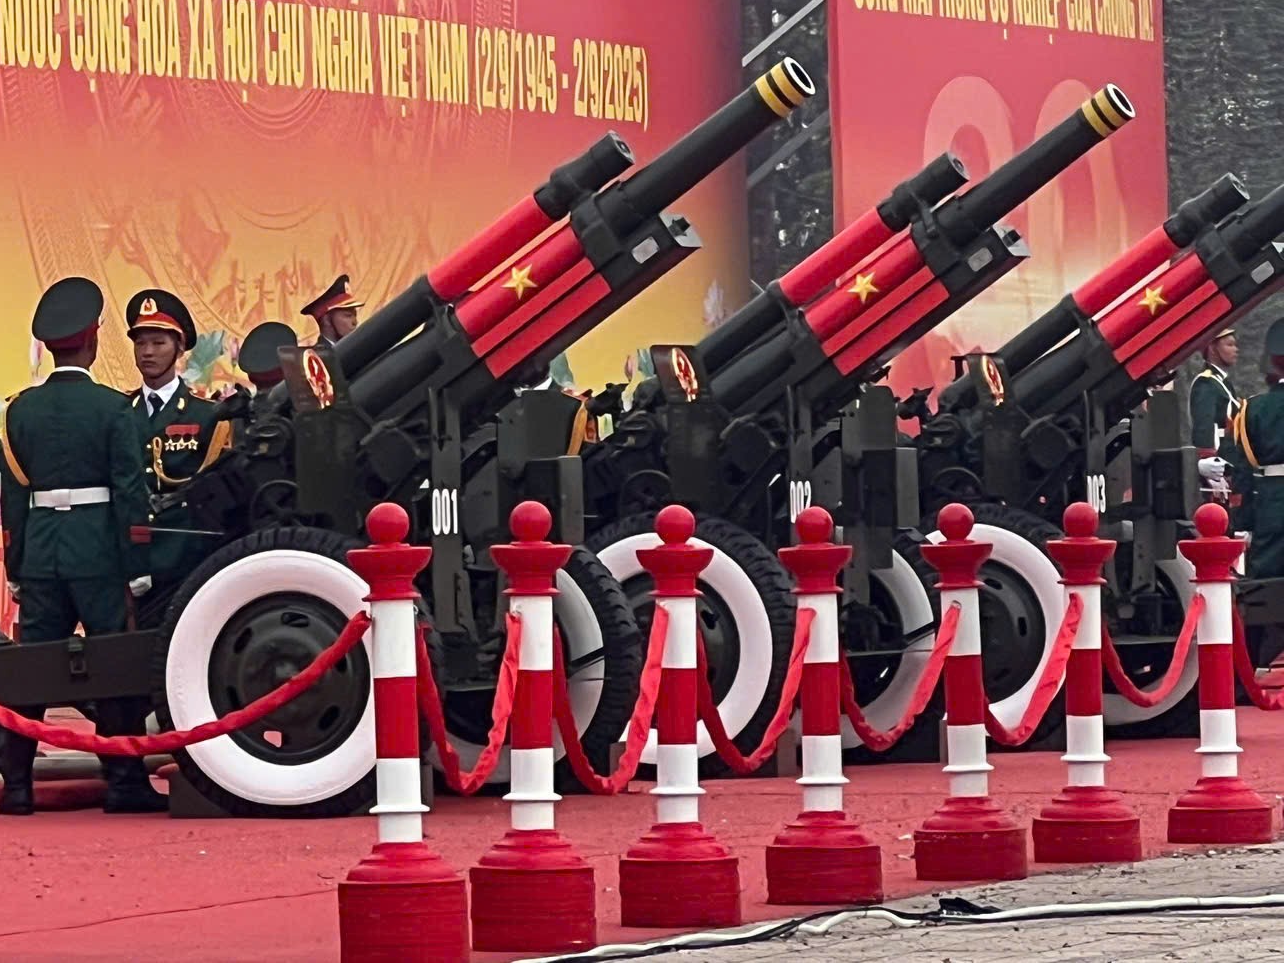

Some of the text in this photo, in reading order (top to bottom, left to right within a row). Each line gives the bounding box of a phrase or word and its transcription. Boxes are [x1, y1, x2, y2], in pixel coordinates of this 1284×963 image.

[425, 19, 469, 105] NAM
[474, 25, 558, 116] (2/9/1945
[573, 39, 649, 132] 2/9/2025)
[432, 488, 458, 535] 001
[790, 480, 811, 524] 002
